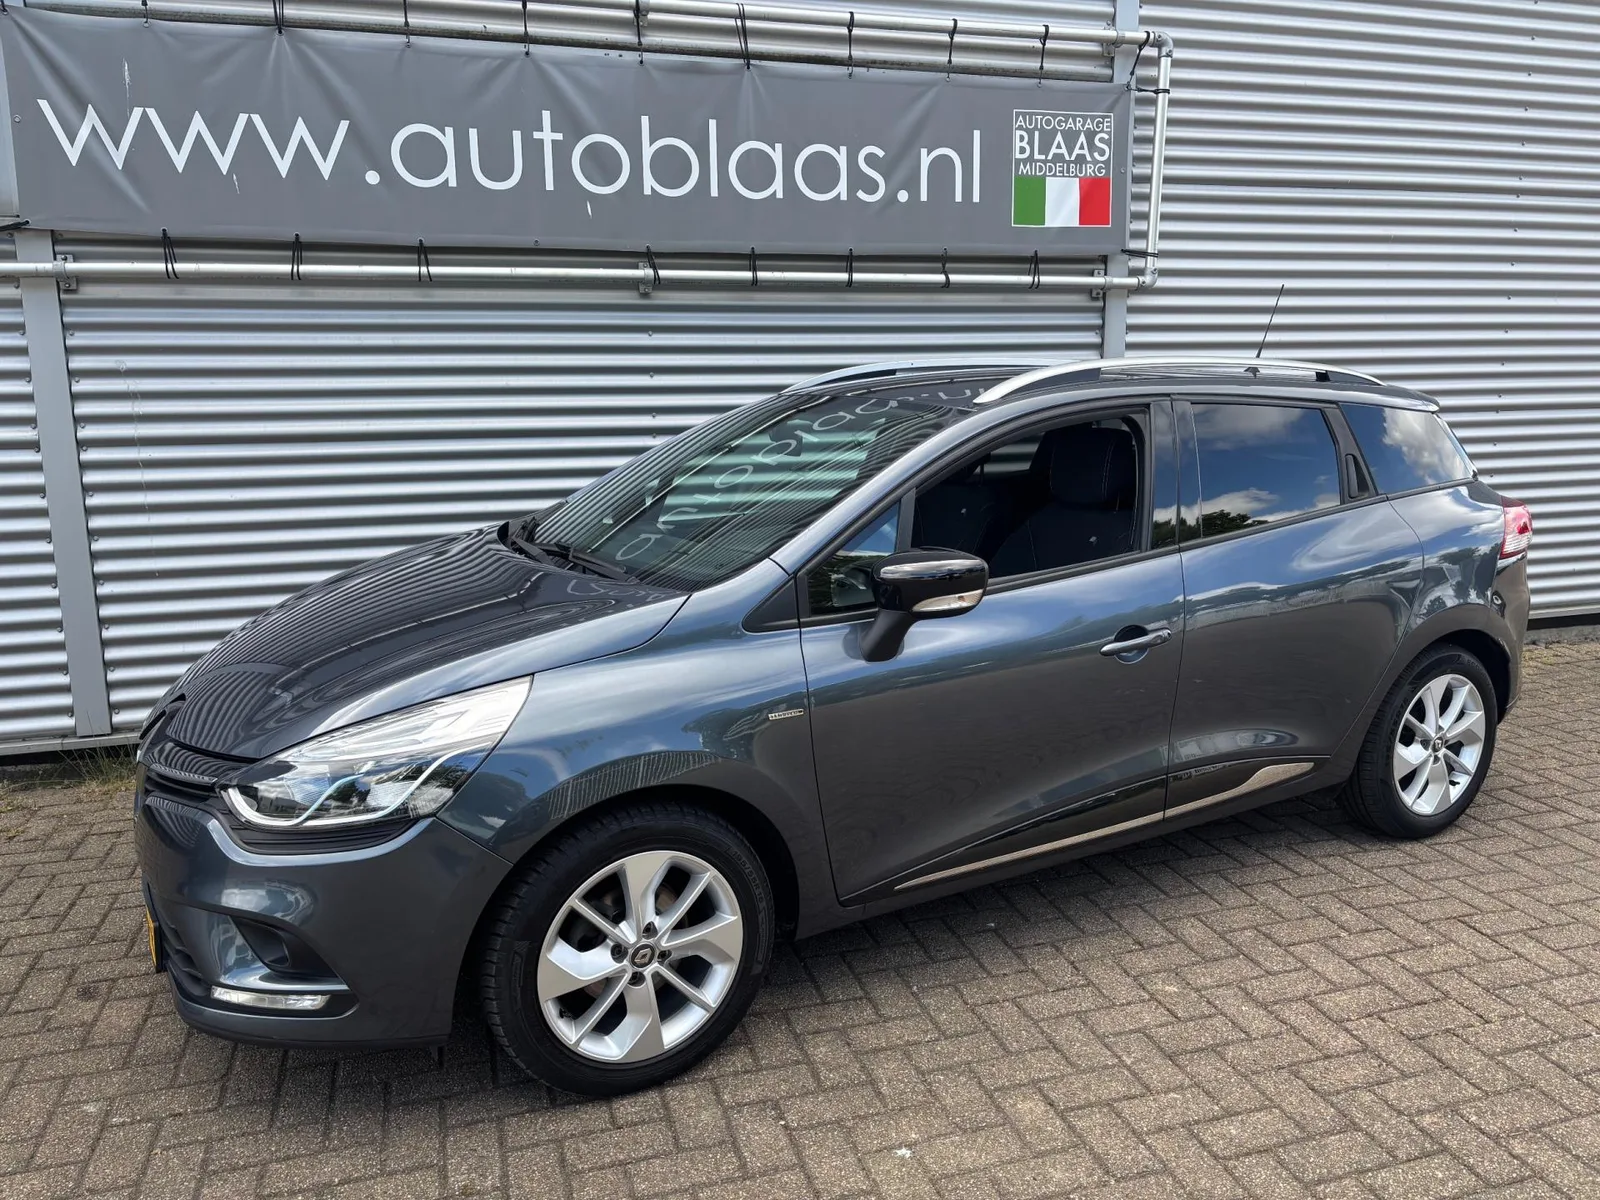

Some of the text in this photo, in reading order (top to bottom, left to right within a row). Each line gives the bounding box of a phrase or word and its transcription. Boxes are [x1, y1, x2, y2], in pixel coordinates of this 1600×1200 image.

[1015, 115, 1111, 131] AUTOGARAGE
[37, 99, 981, 204] www.autoblaas.nl
[1015, 130, 1110, 161] BLAAS
[1018, 161, 1106, 177] MIDDELBURG
